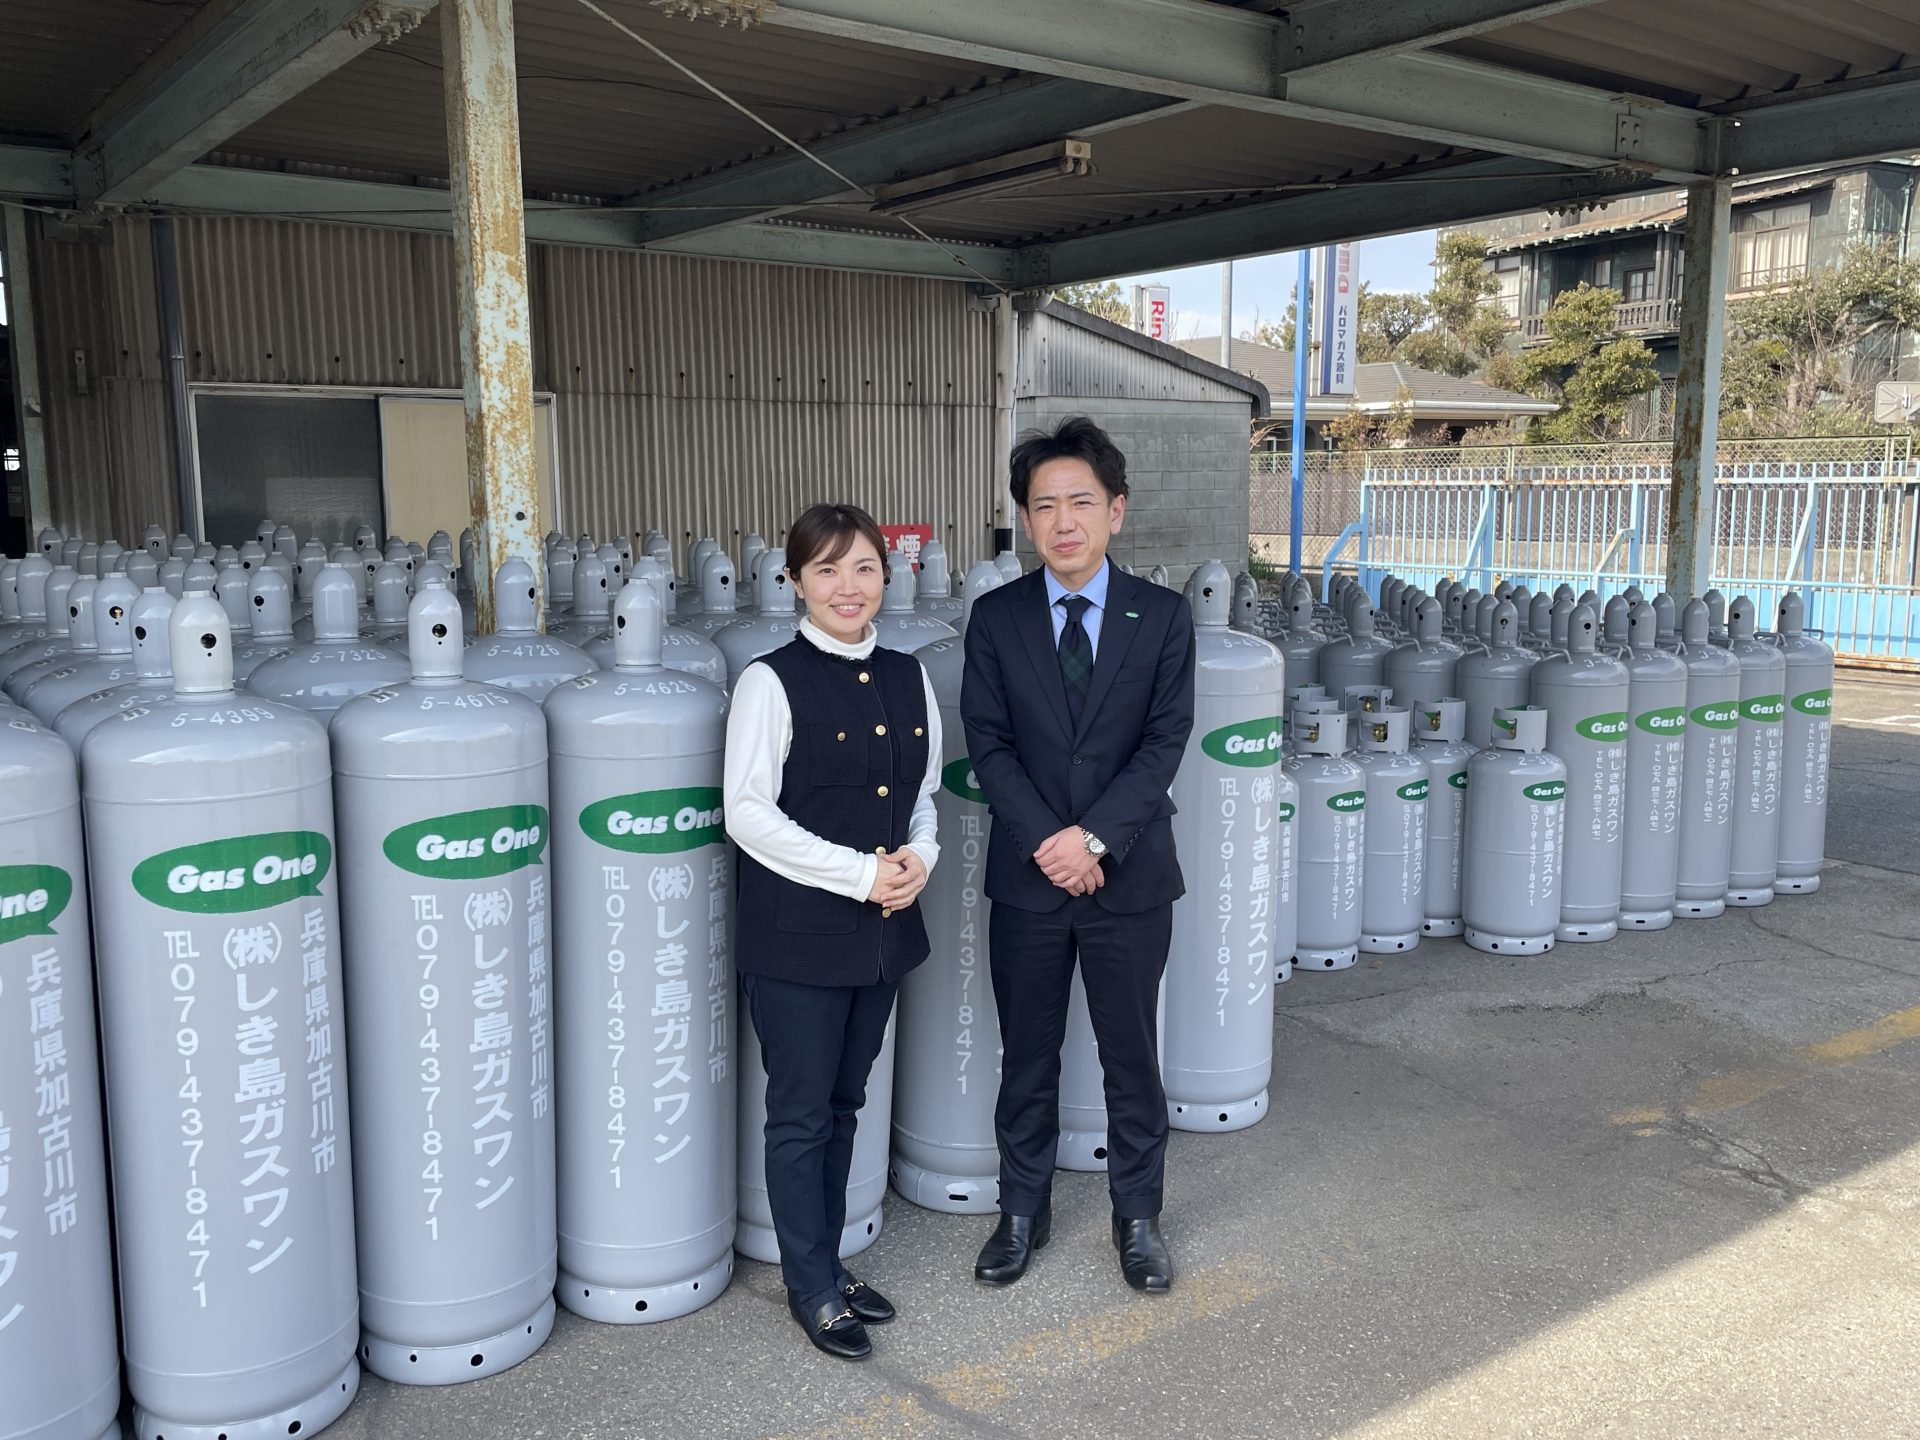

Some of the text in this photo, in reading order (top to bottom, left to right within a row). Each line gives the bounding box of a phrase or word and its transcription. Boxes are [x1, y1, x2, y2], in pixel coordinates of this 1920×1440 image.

[1151, 301, 1165, 338] Rin
[309, 649, 387, 664] 5-7323
[487, 645, 560, 657] 5-4726
[420, 692, 509, 710] 5-4675
[614, 680, 697, 696] 5-4628
[1805, 698, 1826, 709] Gas
[171, 706, 275, 728] 5-4399
[1650, 716, 1675, 728] Gas
[1704, 710, 1728, 721] Gas
[1750, 703, 1774, 715] Gas
[1224, 733, 1265, 755] Gas
[1591, 722, 1616, 734] Gas
[1664, 741, 1680, 833] (株)しき島ガスワン
[1718, 734, 1734, 825] (株)しき島ガスワン
[1764, 727, 1780, 815] (株)しき島ガスワン
[1336, 798, 1353, 807] Gas
[1533, 787, 1551, 796] Gas
[1607, 747, 1622, 843] (株)しき島ガスワン
[606, 806, 723, 836] Gas One
[415, 823, 540, 862] Gas One
[166, 851, 318, 895] Gas One
[1246, 774, 1275, 1006] (株)しき島ガスワン
[708, 853, 729, 1084] 兵庫県加古川市
[526, 875, 549, 1121] 兵庫県加古川市
[648, 863, 695, 1165] (株)しき島ガスワン
[300, 906, 336, 1175] 兵庫県加古川市
[464, 887, 515, 1211] (株)しき島ガスワン
[26, 947, 79, 1237] 兵庫県加古川市
[222, 921, 294, 1275] (株)しき島ガスワン
